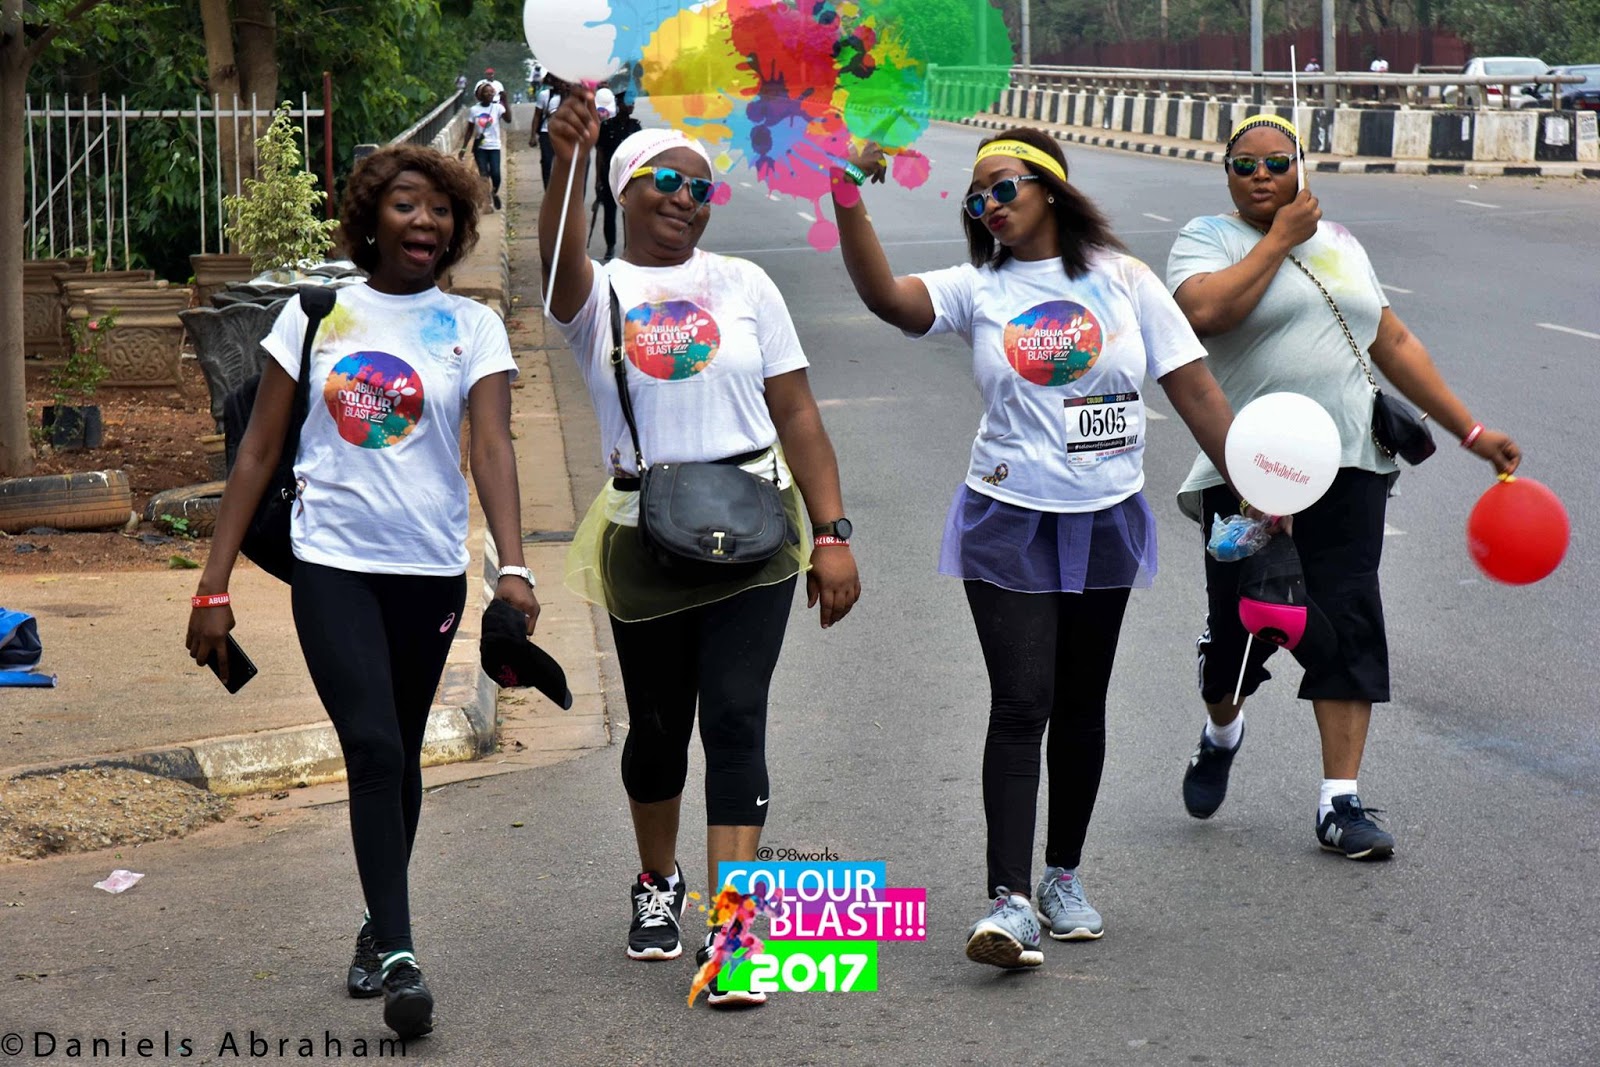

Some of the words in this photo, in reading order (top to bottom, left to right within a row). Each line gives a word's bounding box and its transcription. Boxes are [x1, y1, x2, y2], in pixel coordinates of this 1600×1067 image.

[651, 325, 680, 333] ABUJA
[1034, 329, 1063, 337] ABUJA
[636, 332, 692, 346] COLOUR
[1017, 336, 1073, 350] COLOUR
[646, 344, 672, 355] BLAST
[1028, 350, 1053, 360] BLAST
[354, 382, 384, 397] ABUJA
[338, 389, 392, 412] COLOUR
[345, 407, 371, 420] BLAST
[1079, 407, 1127, 438] 0505
[208, 595, 229, 605] ABUJA
